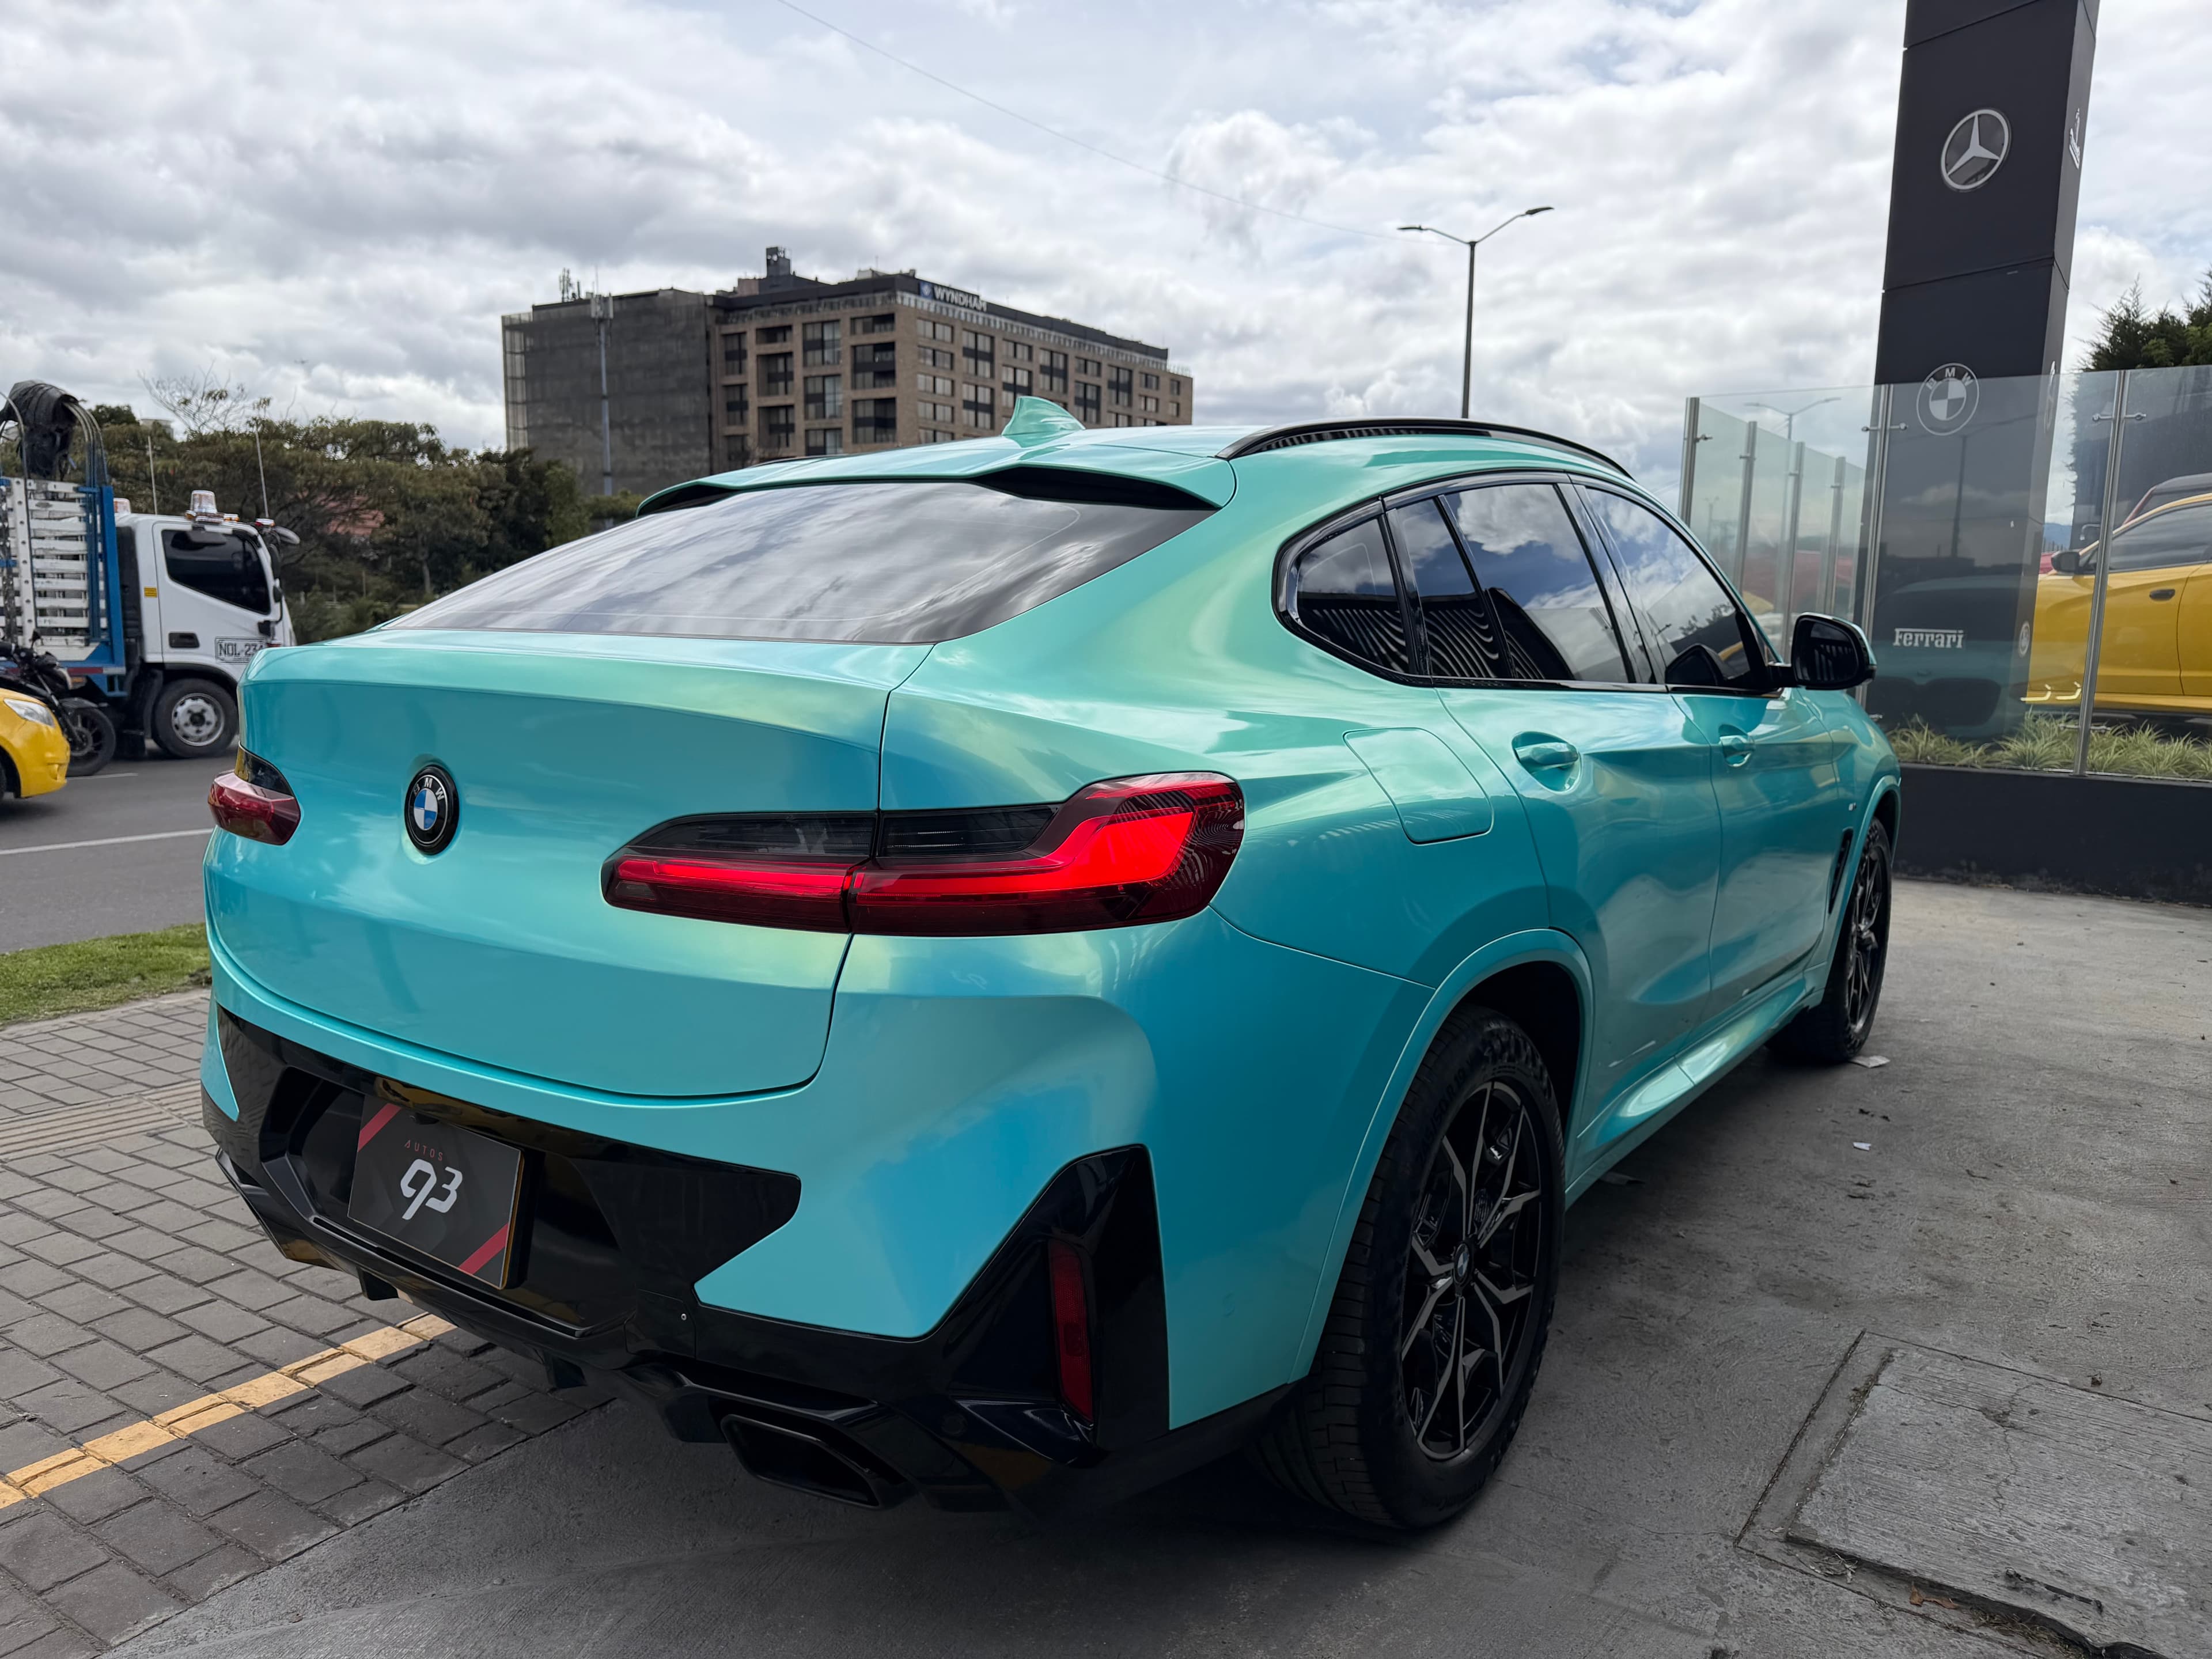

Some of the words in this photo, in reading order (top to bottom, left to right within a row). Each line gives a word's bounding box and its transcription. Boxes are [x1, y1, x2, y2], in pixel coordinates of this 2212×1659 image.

[934, 285, 987, 312] WYNDHAM
[1926, 366, 1974, 391] BMW
[1893, 627, 1964, 649] Ferrari
[413, 777, 445, 801] BMW
[404, 1139, 444, 1161] AUTOS
[400, 1158, 463, 1220] 93
